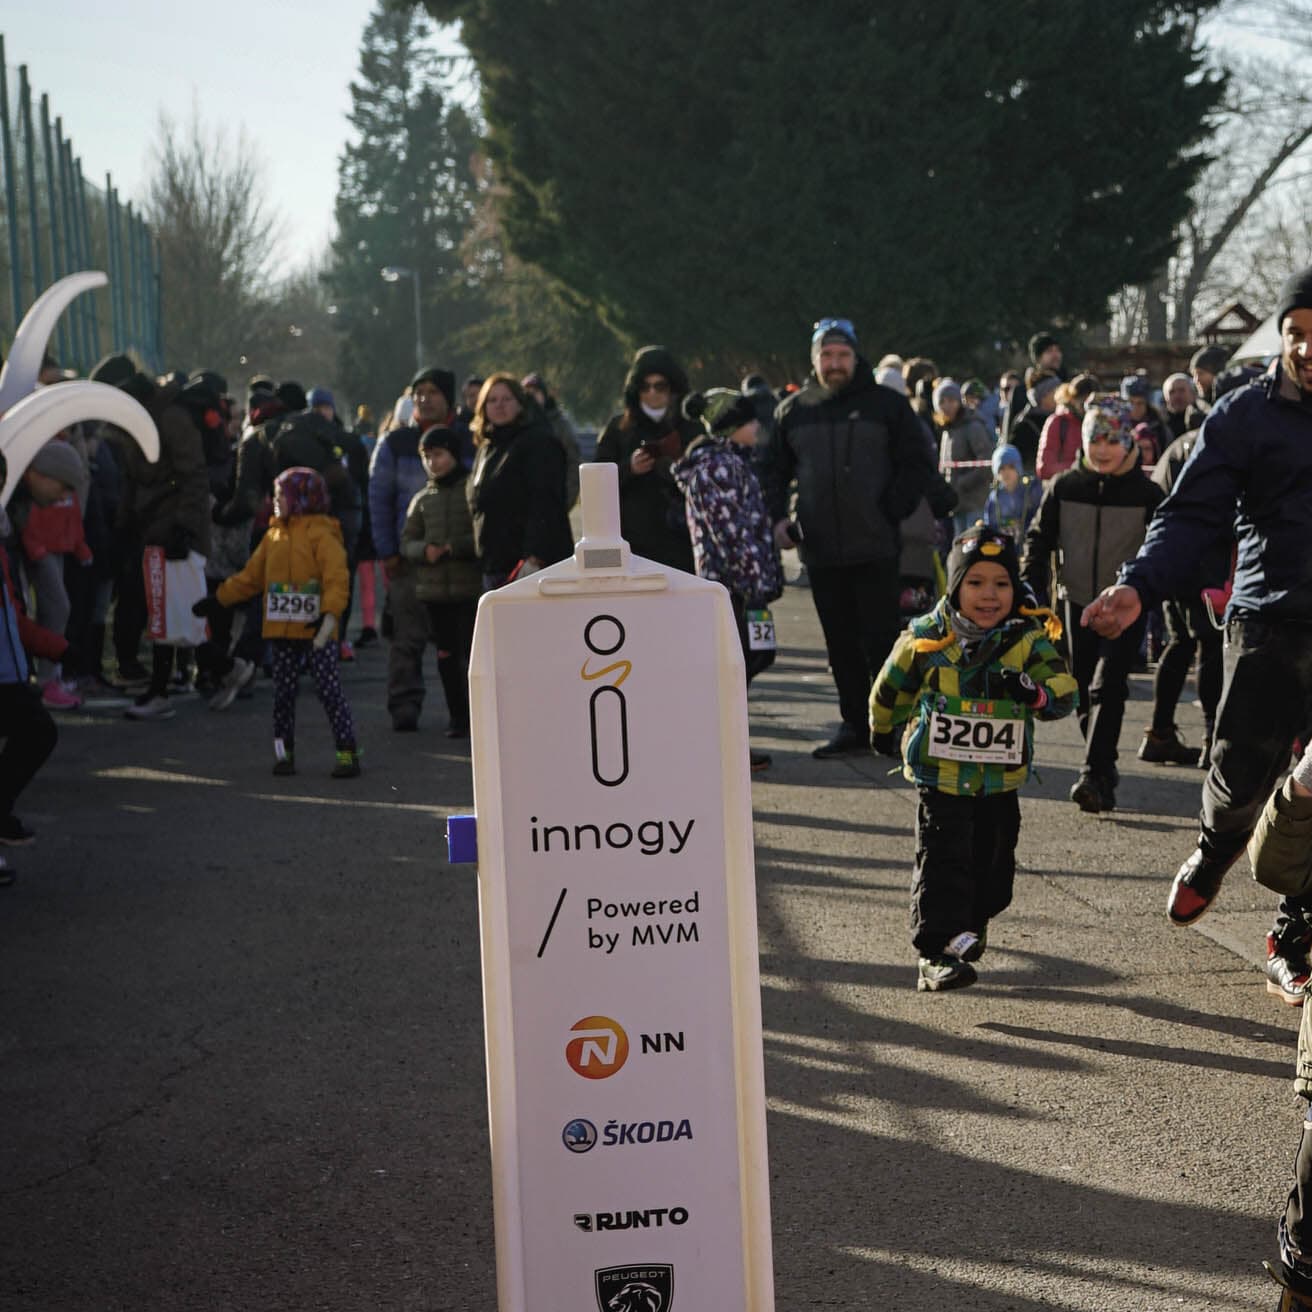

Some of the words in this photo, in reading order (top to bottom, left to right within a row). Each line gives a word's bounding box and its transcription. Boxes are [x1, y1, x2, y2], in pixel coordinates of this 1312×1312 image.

[270, 595, 316, 615] 3296
[933, 716, 1016, 750] 3204
[530, 816, 695, 856] innogy
[587, 891, 700, 919] Powered
[588, 927, 620, 954] by
[632, 922, 699, 947] MVM
[640, 1031, 685, 1054] NN
[602, 1118, 693, 1146] ŠKODA
[595, 1207, 689, 1231] RUNTO
[602, 1270, 666, 1283] PEUGEOT
